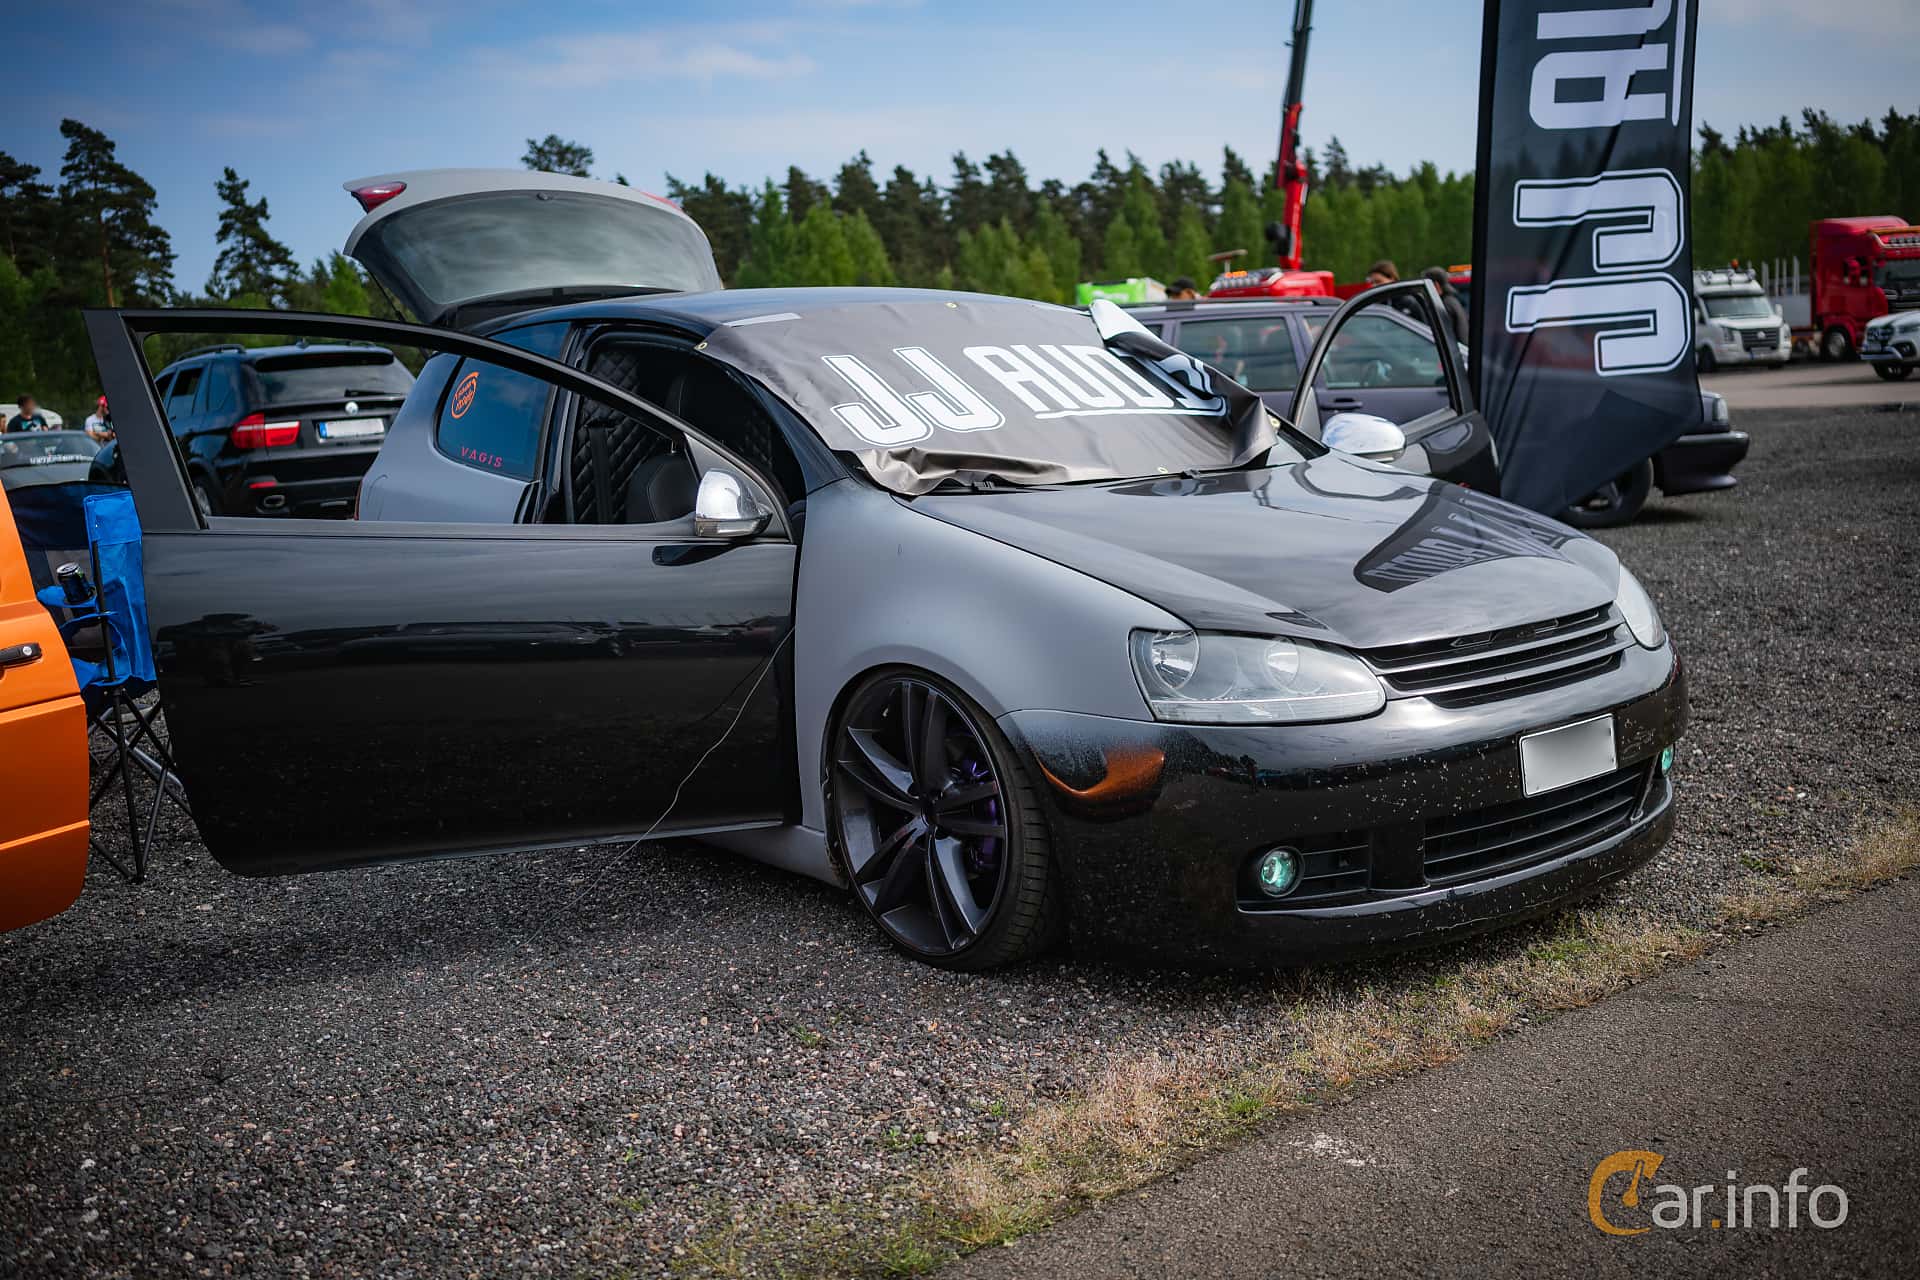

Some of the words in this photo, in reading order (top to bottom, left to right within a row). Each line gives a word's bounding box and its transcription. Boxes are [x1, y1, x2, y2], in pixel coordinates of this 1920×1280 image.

[1505, 168, 1690, 376] JJ
[822, 346, 1006, 447] JJ
[461, 446, 503, 468] VAGIS
